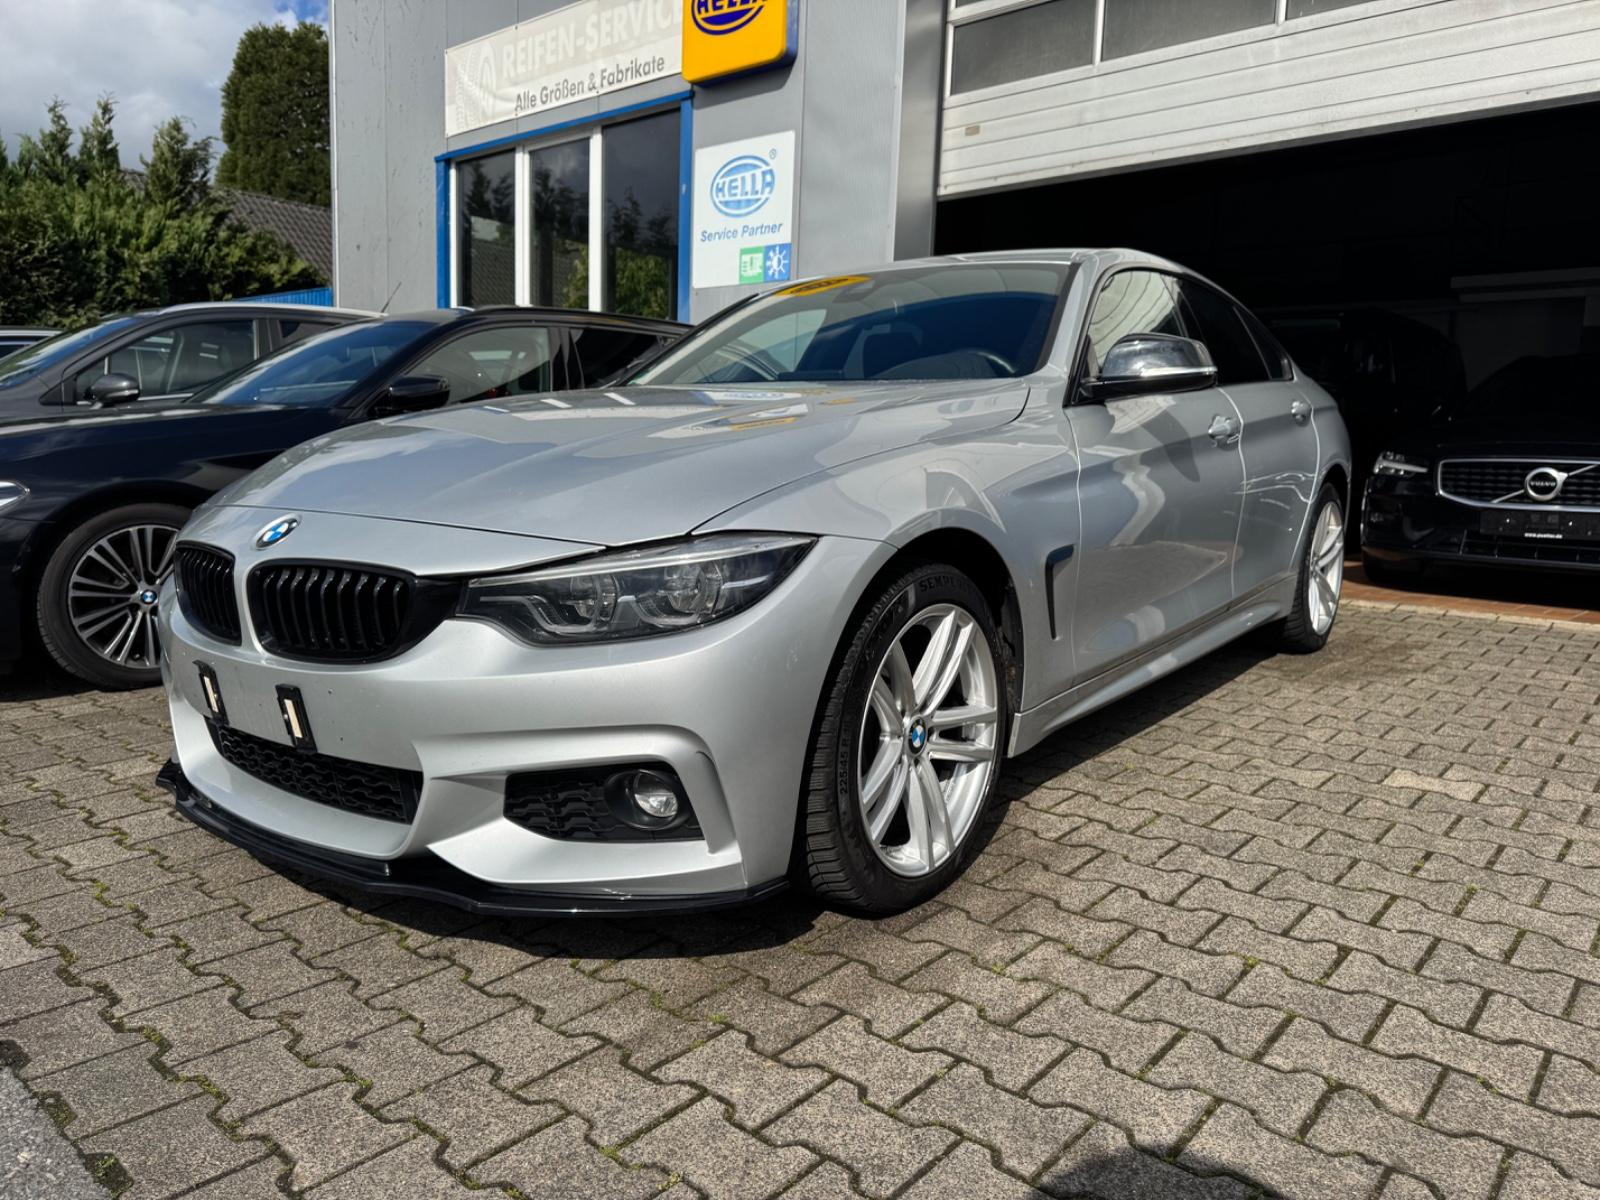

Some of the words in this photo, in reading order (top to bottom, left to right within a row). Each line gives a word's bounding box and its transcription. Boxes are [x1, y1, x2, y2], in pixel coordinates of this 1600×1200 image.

[515, 90, 537, 112] Alle
[540, 81, 585, 105] Größen
[588, 72, 597, 91] &
[600, 55, 665, 89] Fabrikate
[714, 167, 775, 198] HELLA
[700, 227, 738, 242] Service
[741, 222, 783, 238] Partner
